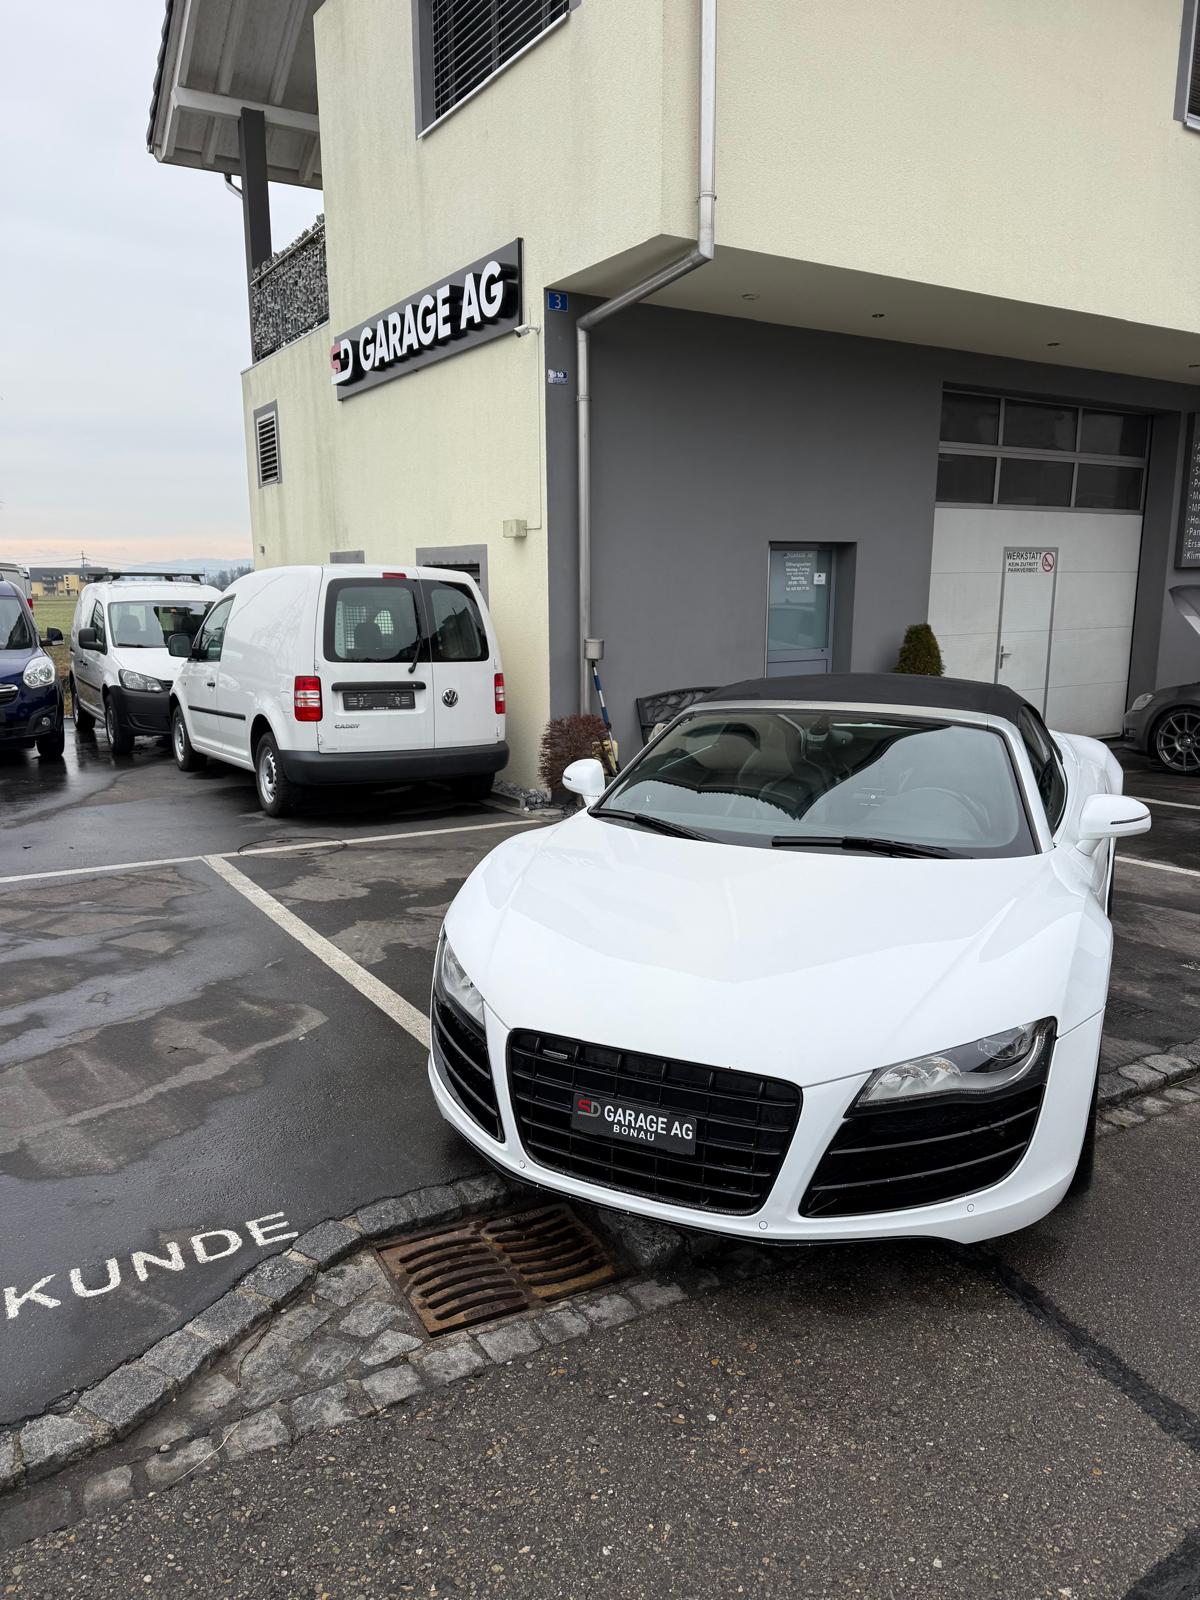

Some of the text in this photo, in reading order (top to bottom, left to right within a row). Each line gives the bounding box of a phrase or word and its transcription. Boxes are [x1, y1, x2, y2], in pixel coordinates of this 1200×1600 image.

[359, 284, 451, 371] GARAGE
[460, 260, 504, 330] AG
[554, 294, 562, 309] 3
[1007, 552, 1042, 560] WERKSTATT
[577, 1099, 693, 1140] SD GARAGE AG
[613, 1124, 655, 1141] BONAU
[3, 1211, 299, 1320] KUNDE
